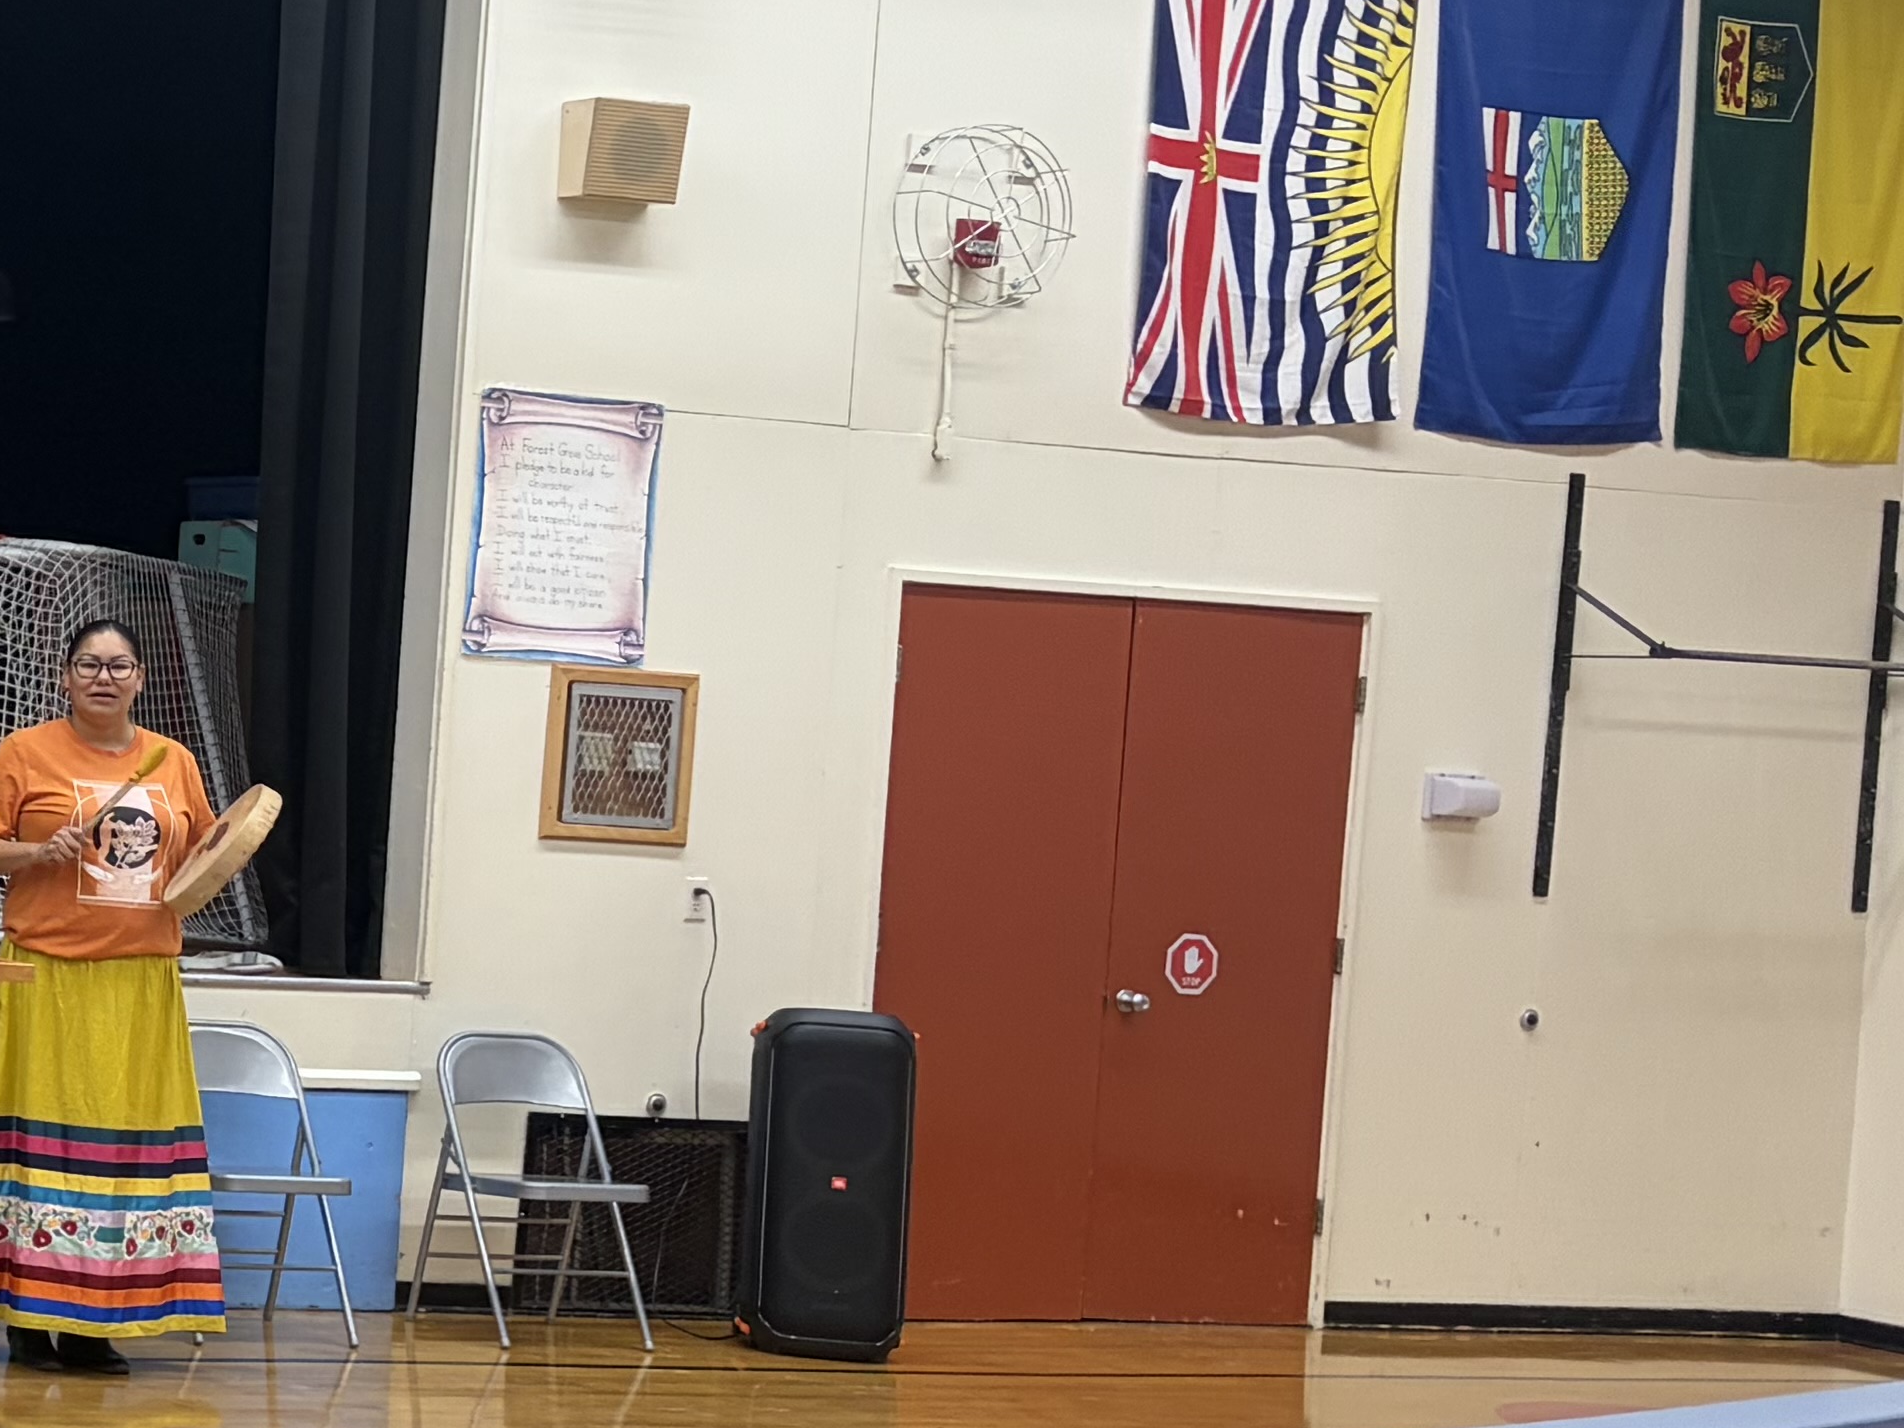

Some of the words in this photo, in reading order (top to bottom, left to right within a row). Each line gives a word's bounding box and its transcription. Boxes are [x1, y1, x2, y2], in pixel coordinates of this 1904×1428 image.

[500, 434, 514, 451] At
[522, 437, 555, 456] Forest
[585, 443, 621, 462] School
[499, 453, 510, 468] I
[496, 488, 509, 502] I
